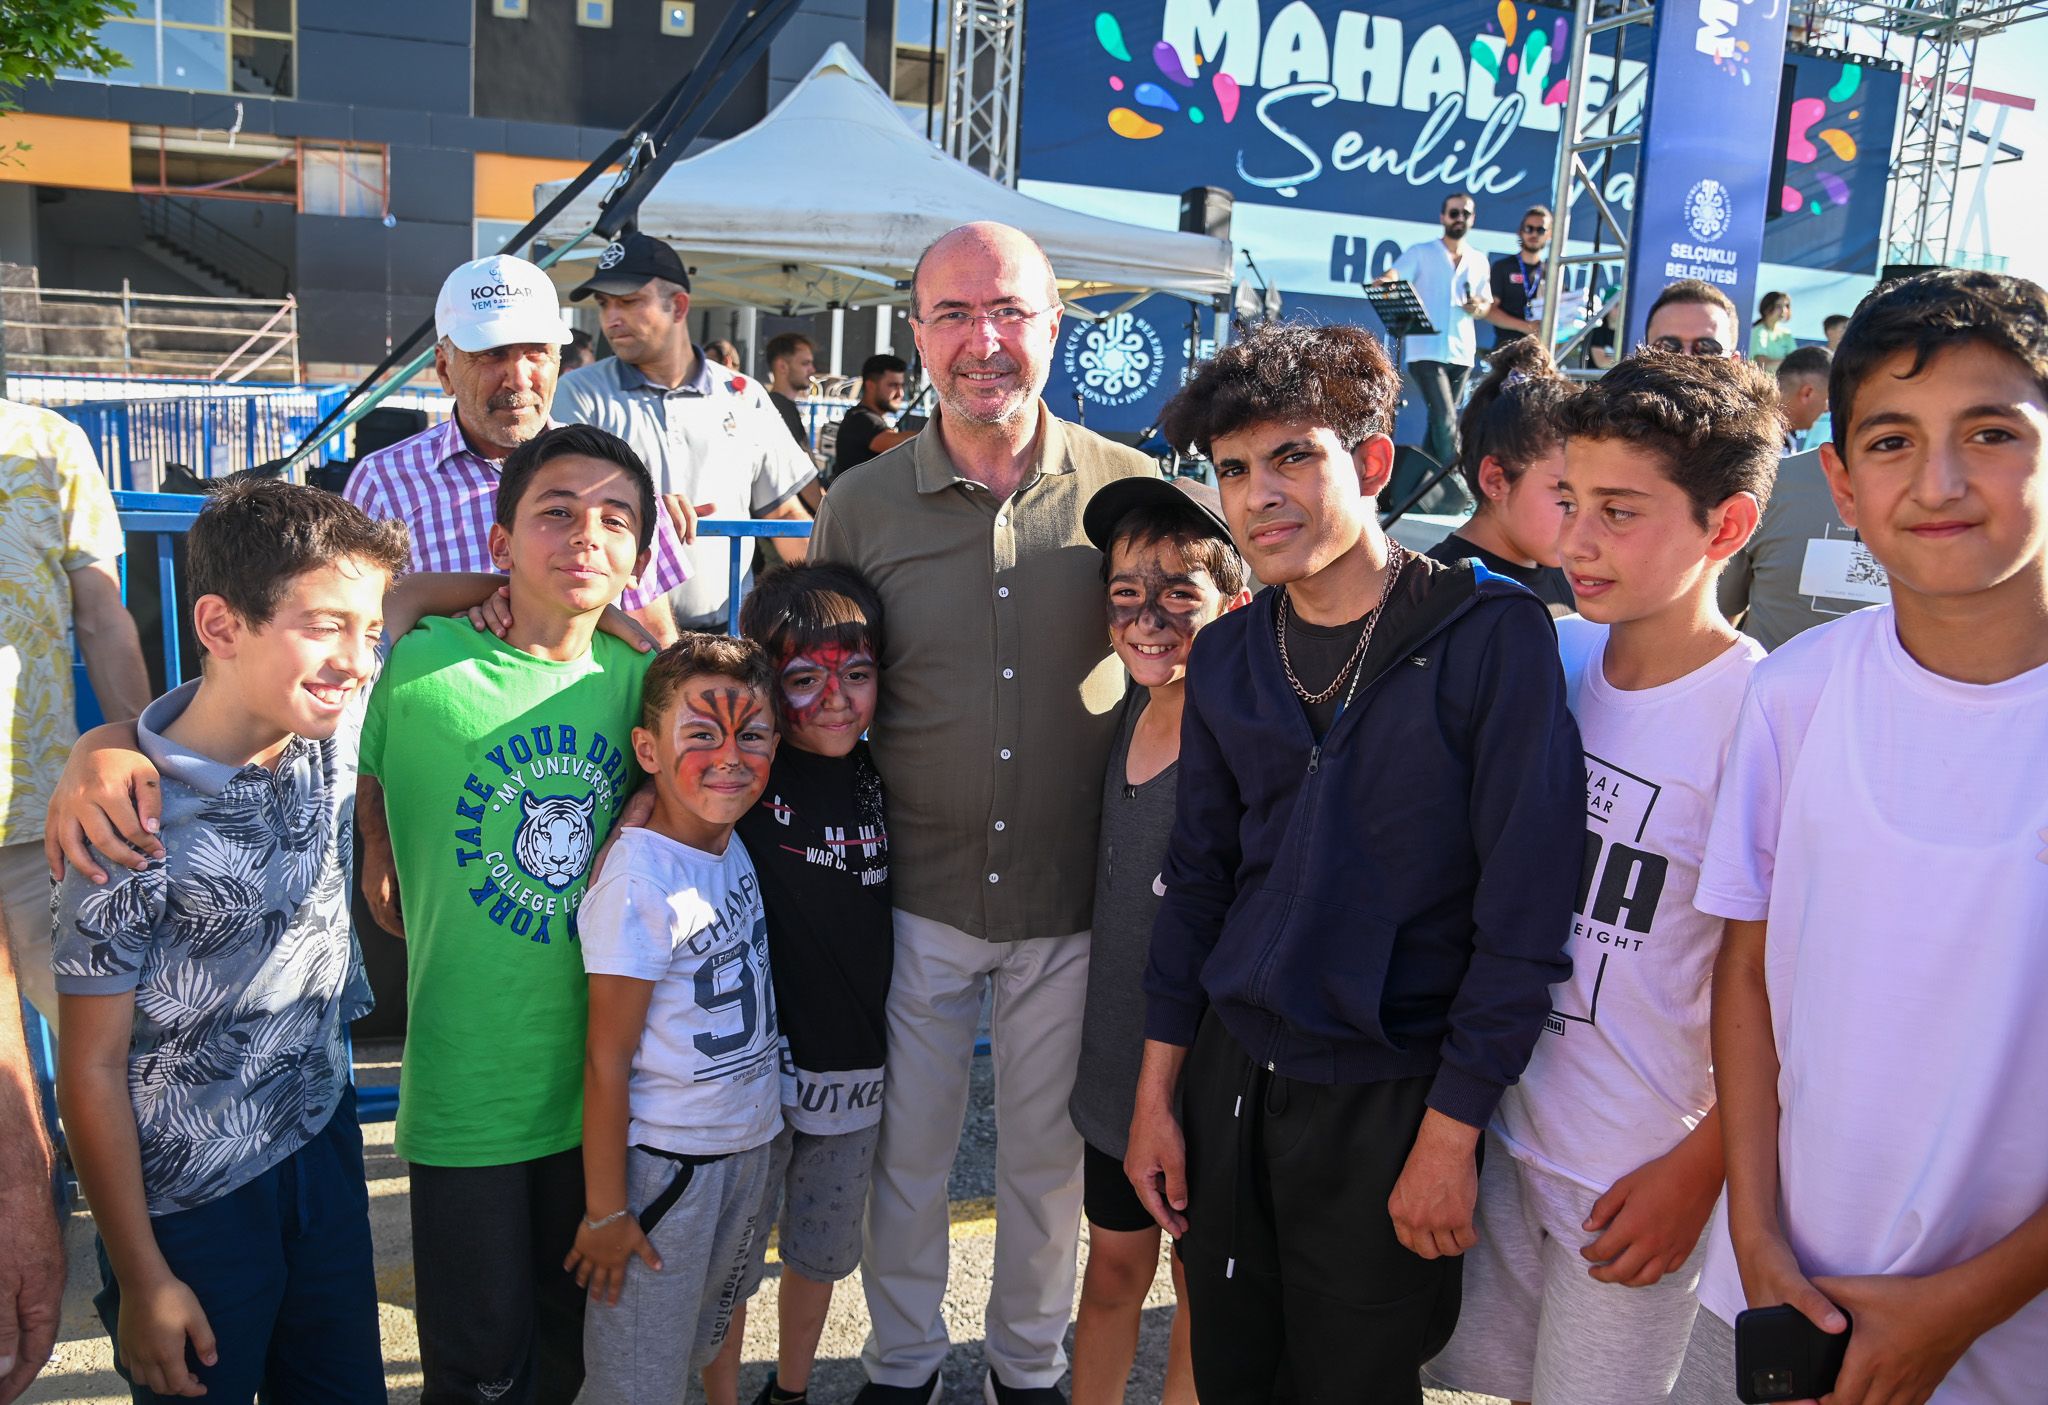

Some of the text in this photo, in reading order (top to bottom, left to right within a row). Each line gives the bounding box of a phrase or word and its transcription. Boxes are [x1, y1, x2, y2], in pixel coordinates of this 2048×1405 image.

[1236, 81, 1528, 198] Şenlik
[1665, 261, 1738, 285] BELEDİYESİ
[1670, 242, 1738, 265] SELÇUKLU
[472, 300, 492, 310] YEM
[455, 773, 495, 867] TAKE
[485, 724, 578, 775] YOUR
[496, 756, 612, 807] MY UNIVERSE
[806, 846, 834, 867] WAR
[485, 851, 557, 915] COLLEGE
[468, 875, 551, 944] YORK
[1573, 922, 1644, 952] EIGHT
